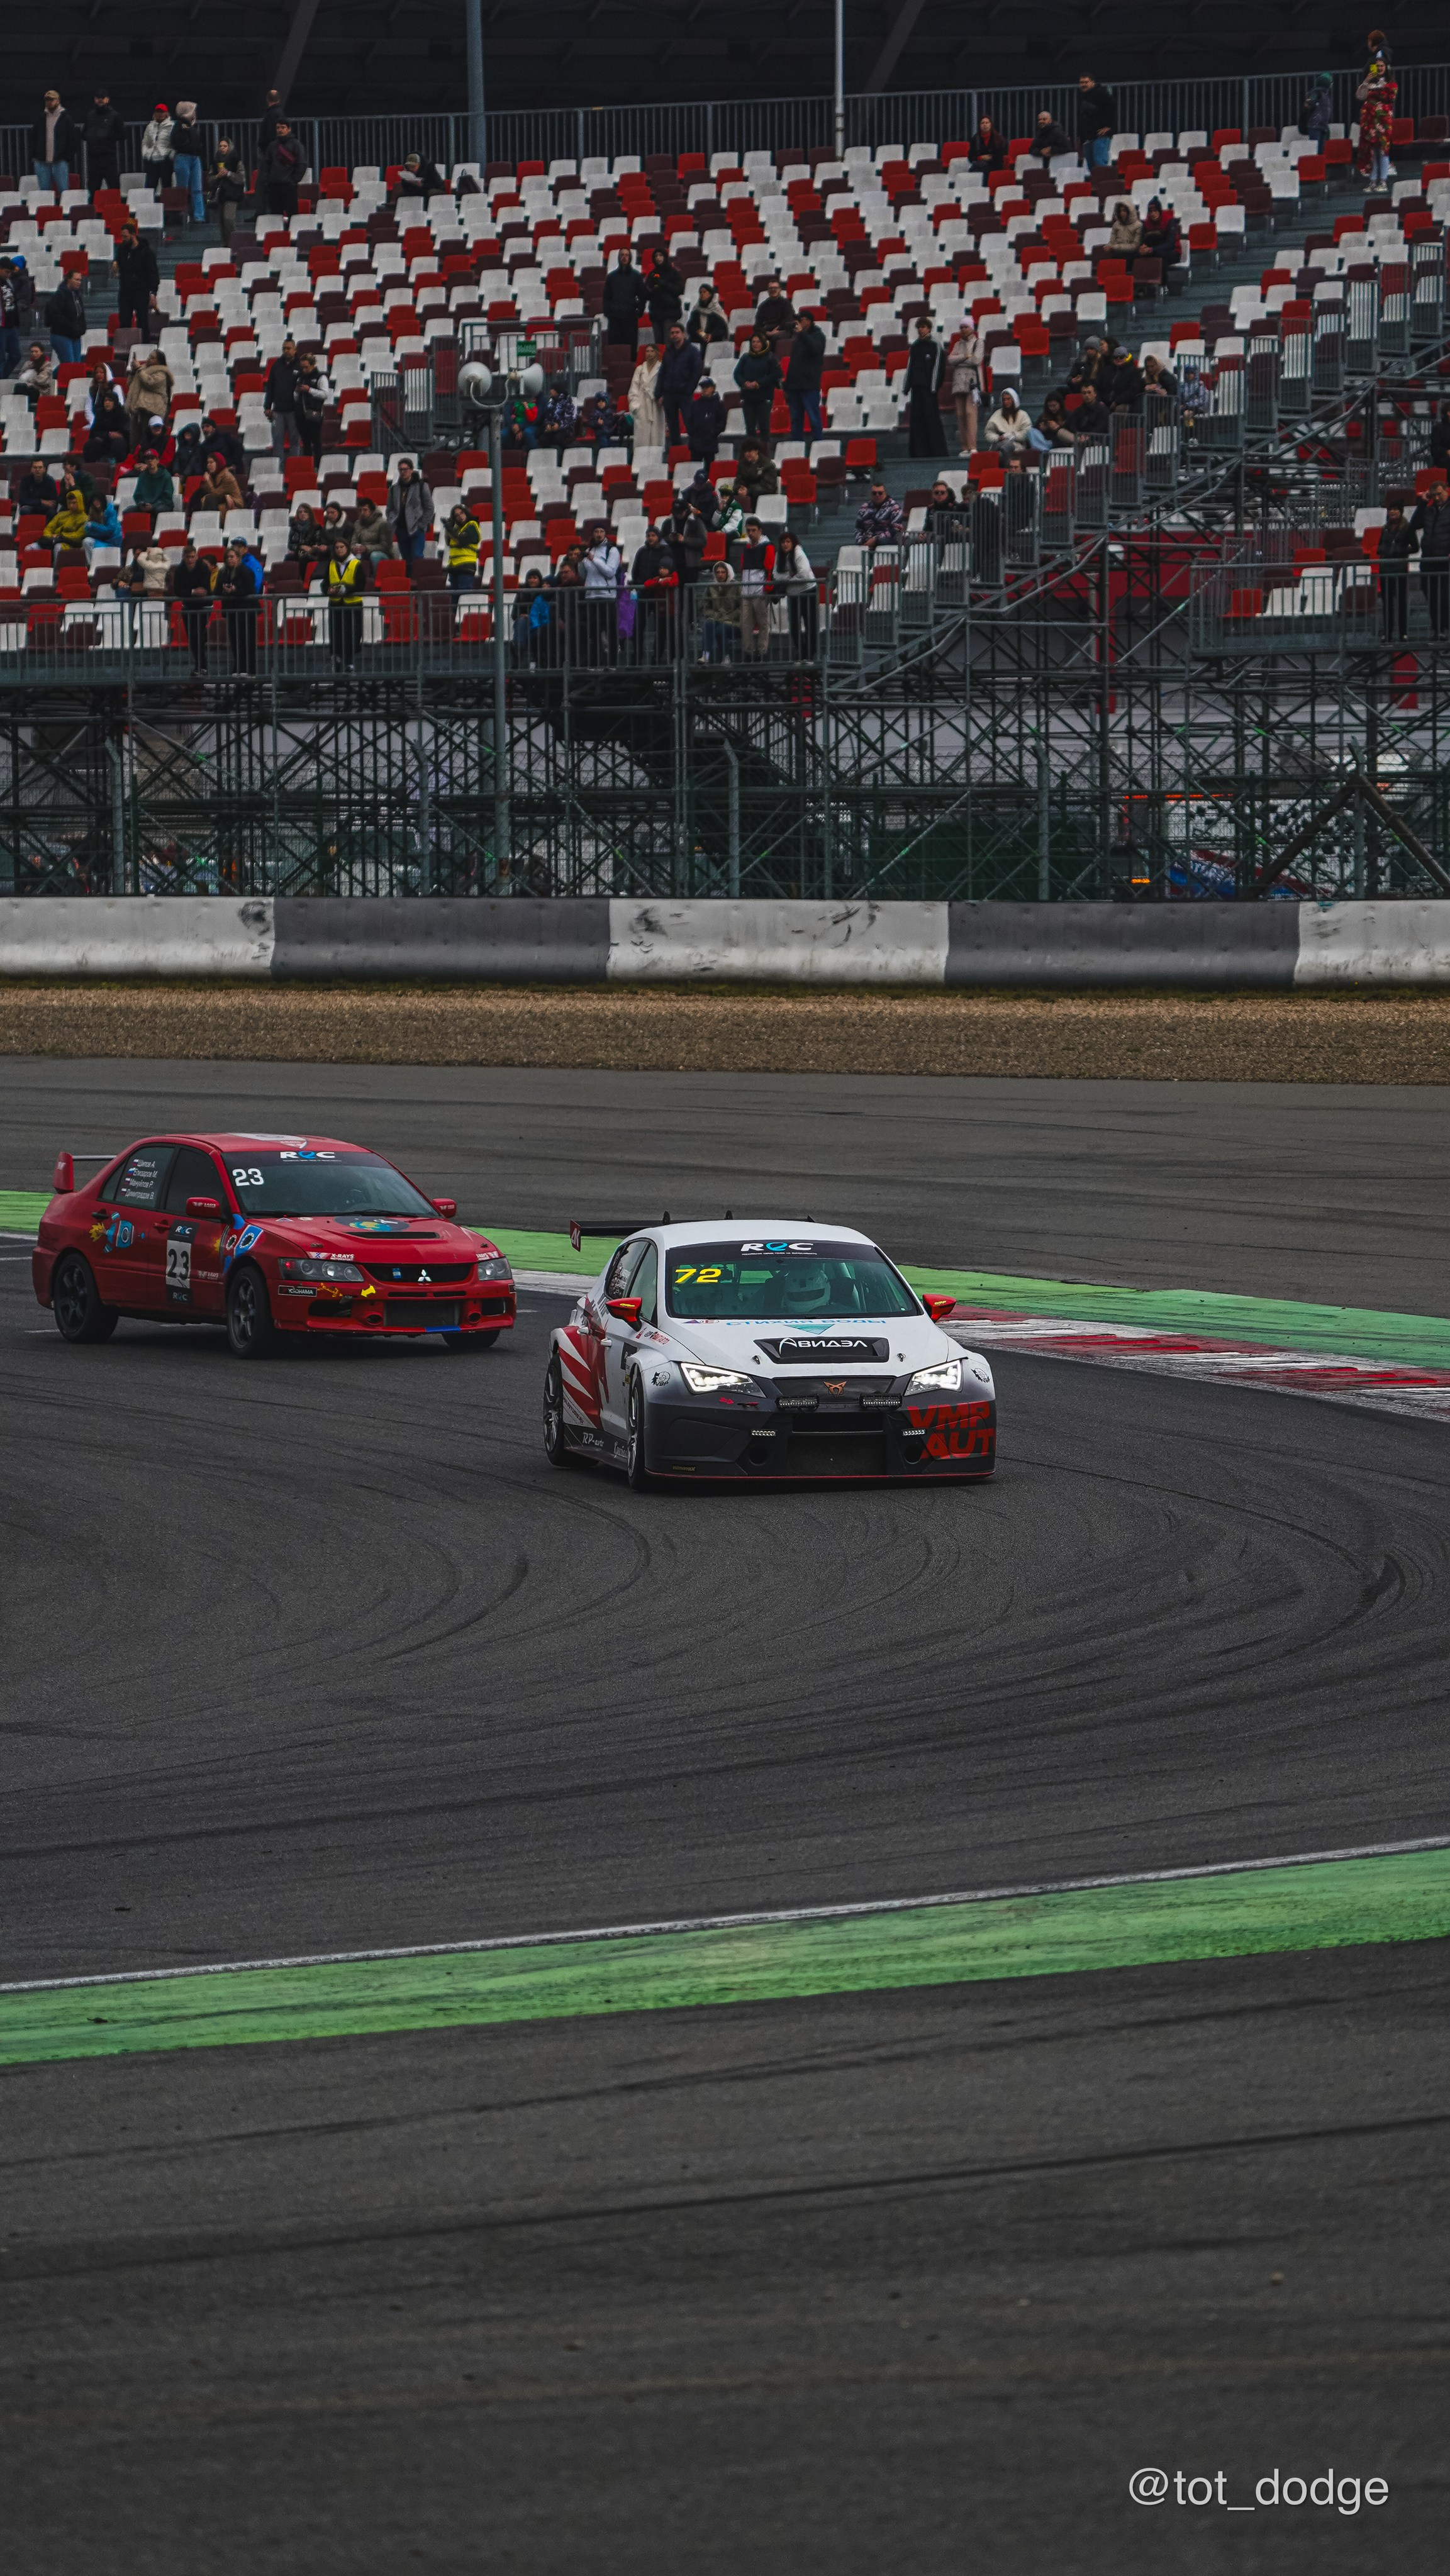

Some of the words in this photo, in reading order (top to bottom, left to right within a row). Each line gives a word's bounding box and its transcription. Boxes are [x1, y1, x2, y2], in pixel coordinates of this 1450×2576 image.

[232, 1168, 264, 1186] 23
[167, 1248, 189, 1280] 23
[675, 1269, 722, 1283] 72
[779, 1337, 867, 1354] АВИДЭЛ
[907, 1401, 990, 1430] VMP
[920, 1428, 996, 1460] AUT
